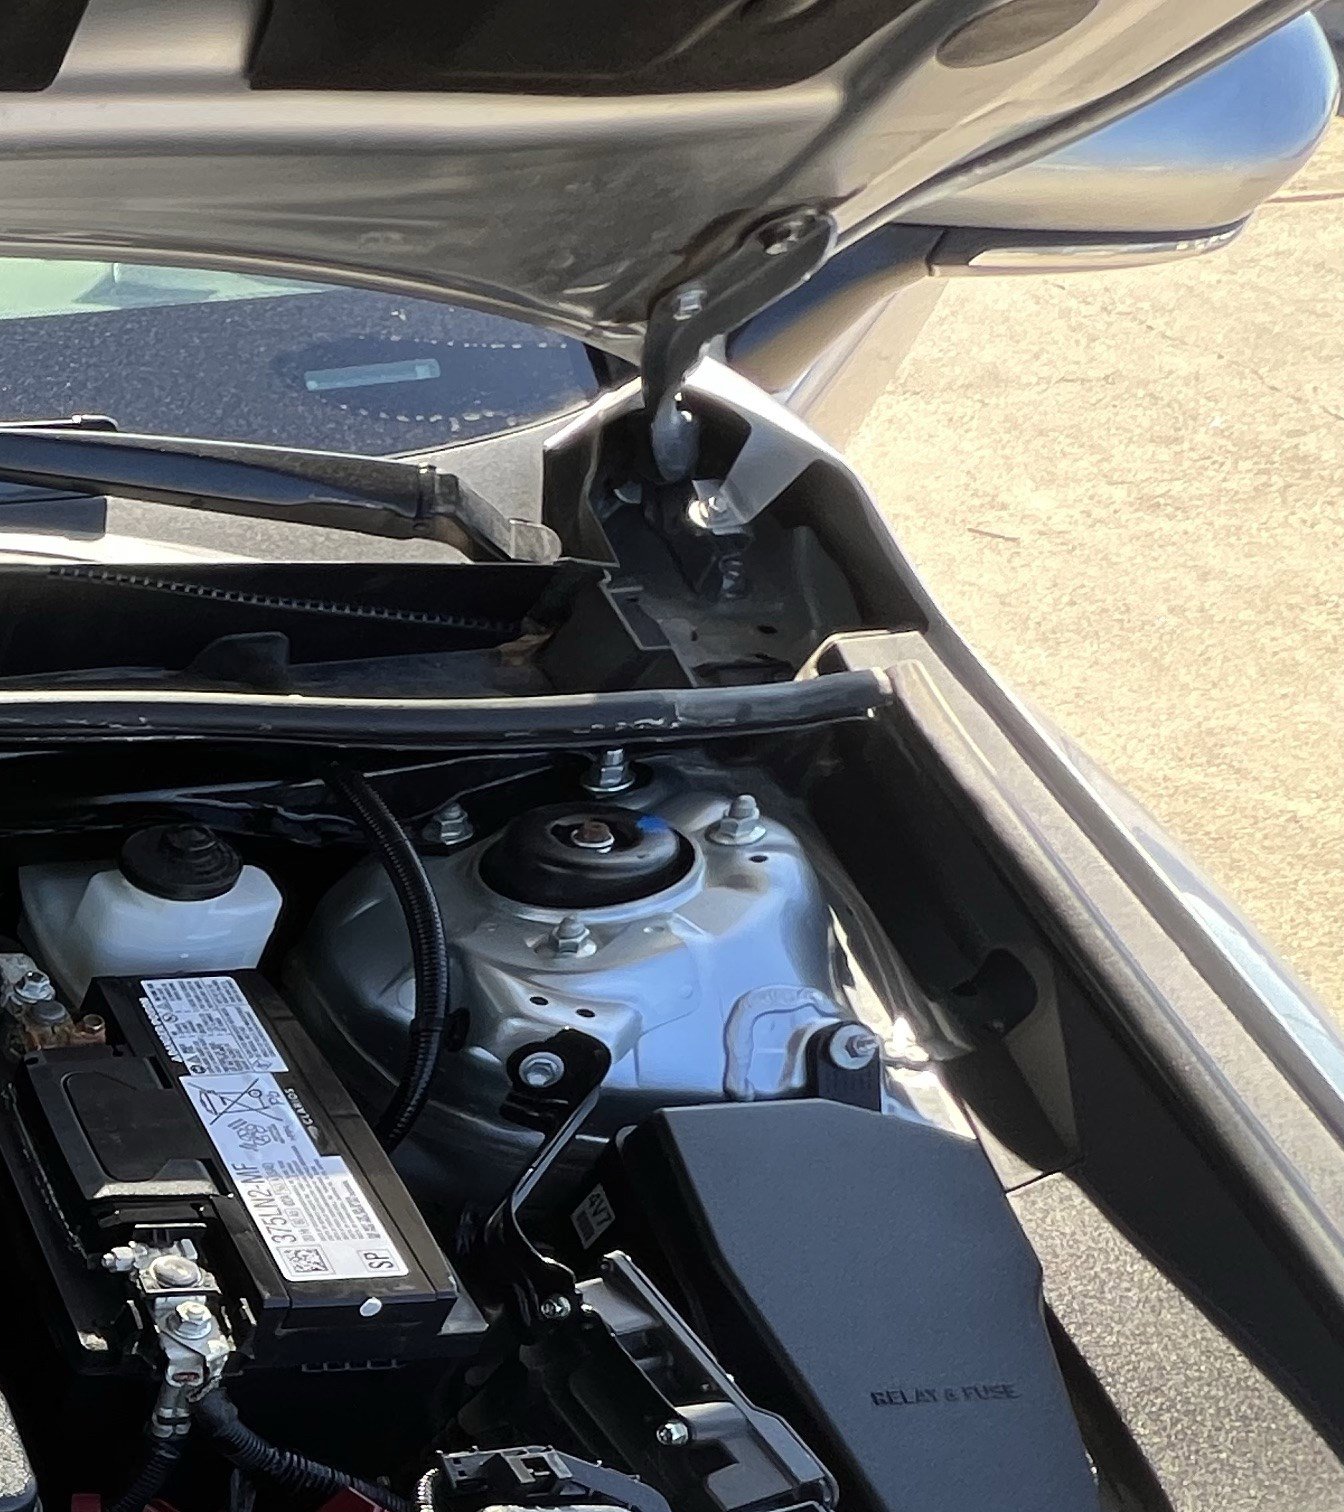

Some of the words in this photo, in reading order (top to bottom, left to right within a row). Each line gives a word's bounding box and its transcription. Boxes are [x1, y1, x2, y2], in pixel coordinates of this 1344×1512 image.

[231, 1162, 297, 1244] 375LN2-MF
[363, 1251, 395, 1270] SP
[870, 1387, 937, 1406] RELAY
[962, 1383, 1023, 1401] FUSE
